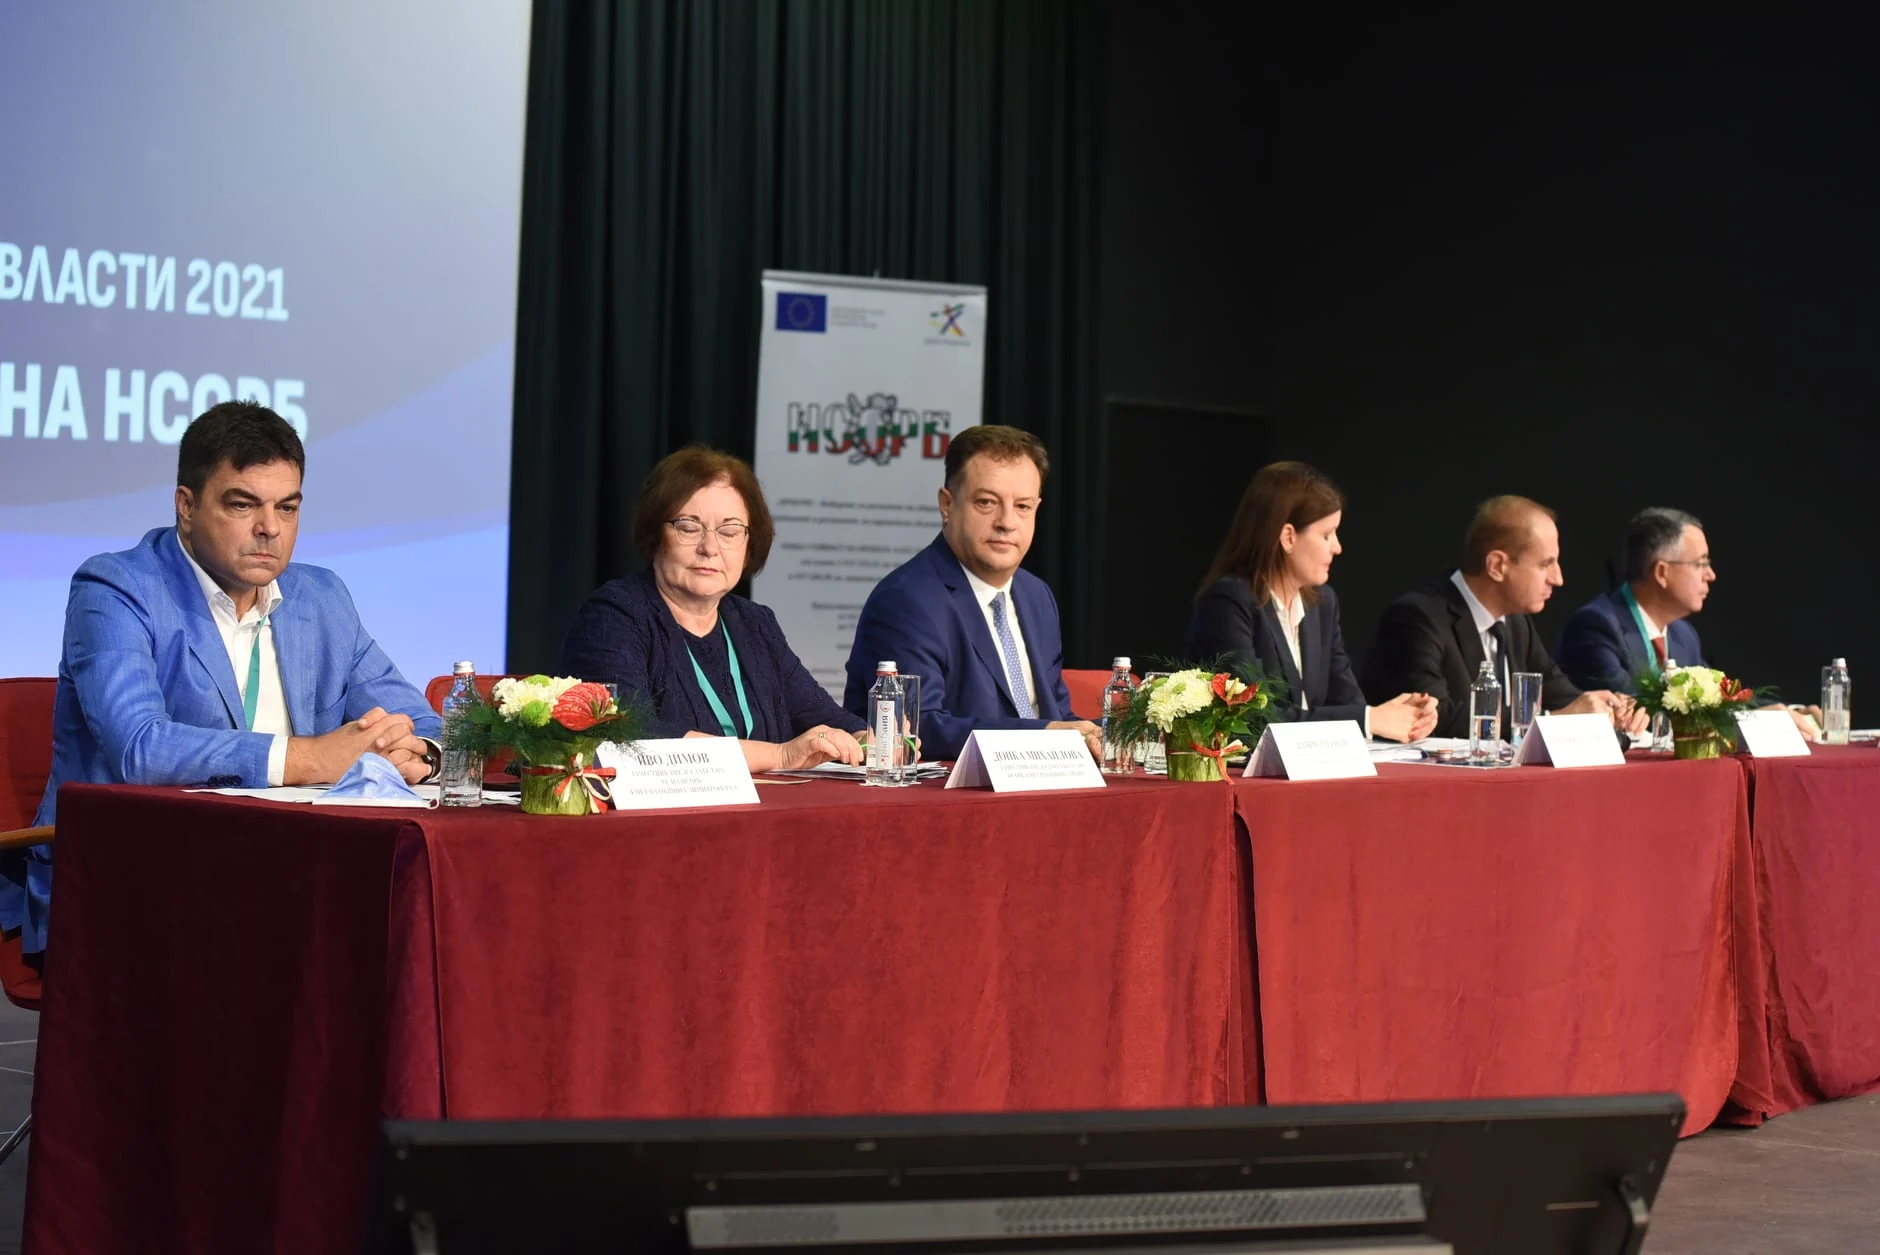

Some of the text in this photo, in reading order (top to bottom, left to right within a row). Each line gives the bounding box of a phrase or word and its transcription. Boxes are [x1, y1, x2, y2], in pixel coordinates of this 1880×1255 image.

[0, 242, 289, 321] ВЛАСТИ 2021
[0, 362, 88, 440] НА
[666, 752, 710, 766] ДИМОВ
